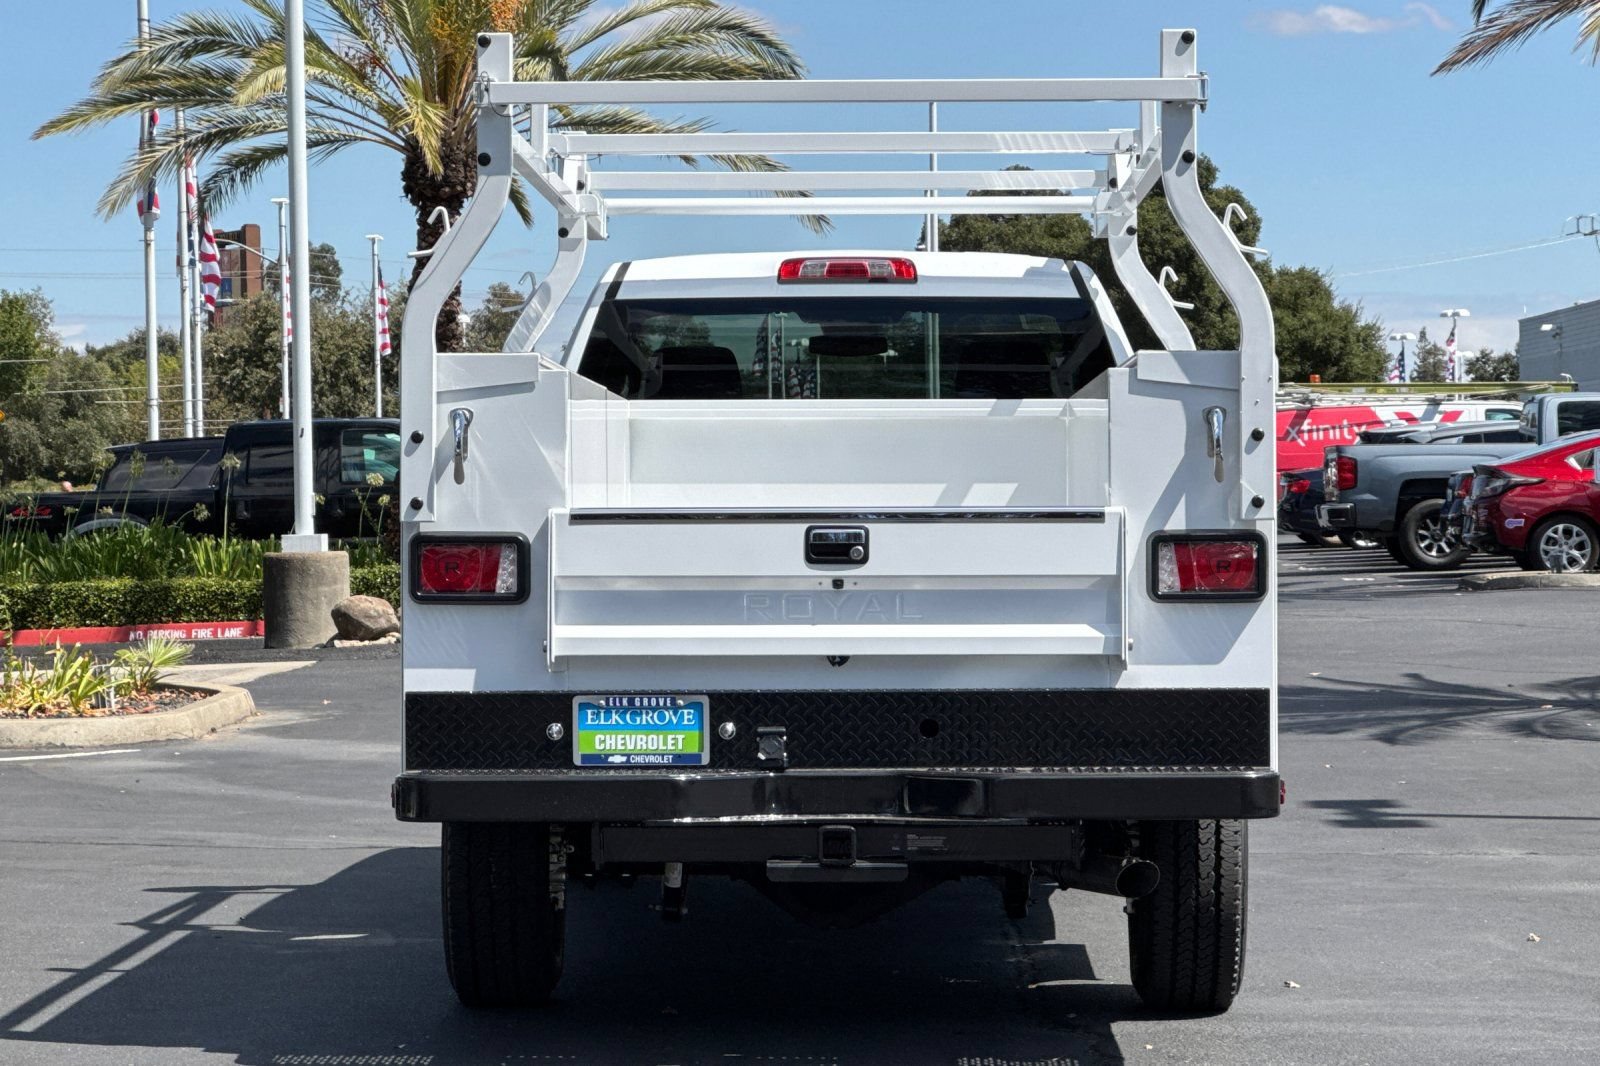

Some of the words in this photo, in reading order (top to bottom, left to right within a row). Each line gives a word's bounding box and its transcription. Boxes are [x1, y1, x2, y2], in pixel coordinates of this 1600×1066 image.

[1286, 419, 1367, 447] xfinity
[743, 592, 924, 621] ROYAL
[129, 630, 144, 641] NO
[147, 628, 186, 640] PARKING
[191, 628, 214, 639] FIRE
[217, 627, 244, 638] LANE
[609, 697, 629, 707] ELK
[634, 697, 672, 707] GROVE
[594, 734, 686, 750] CHEVROLET
[629, 754, 673, 764] CHEVROLET
